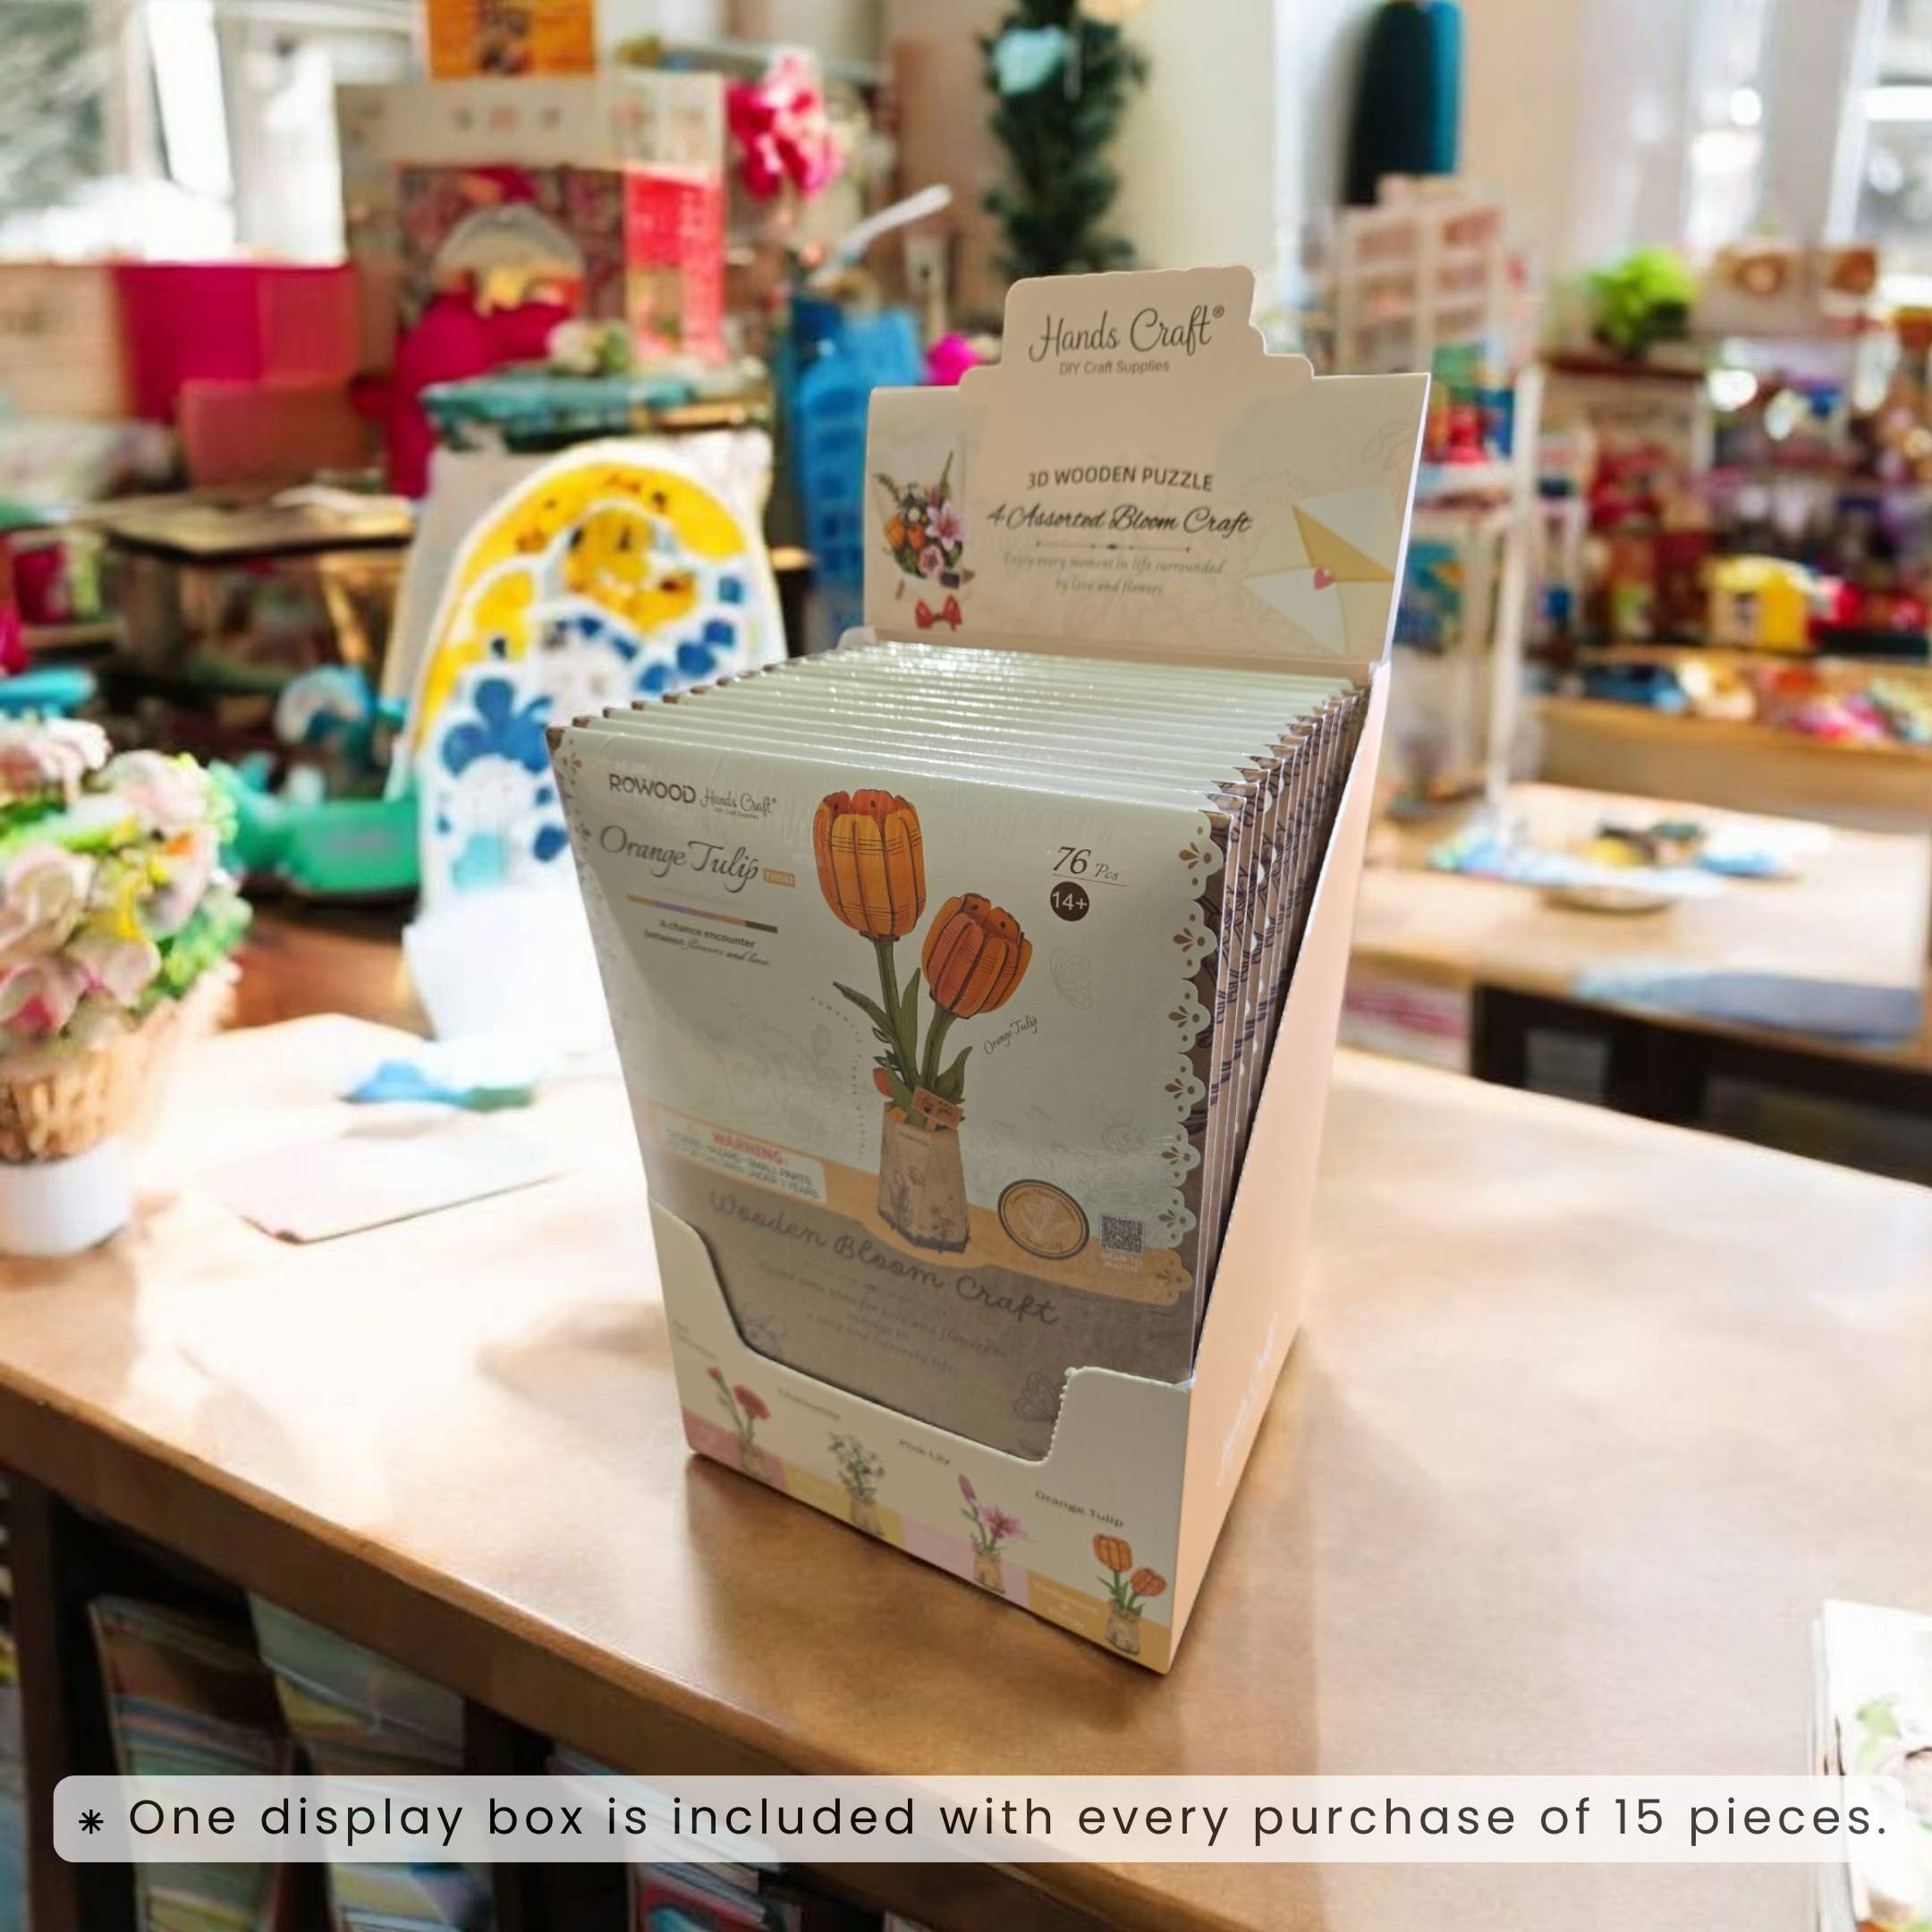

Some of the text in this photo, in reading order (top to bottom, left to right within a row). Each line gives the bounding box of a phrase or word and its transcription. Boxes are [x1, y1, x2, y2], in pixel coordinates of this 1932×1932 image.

[1029, 309, 1120, 362] Hands
[1059, 359, 1170, 376] DIY Craft Supplies
[1028, 465, 1213, 492] 3D WOODEN PUZZLE
[987, 503, 1252, 538] 4 Assorted Bloom Craft
[1036, 555, 1065, 572] every
[1070, 557, 1114, 571] moment
[1117, 557, 1128, 570] in
[1156, 557, 1225, 574] surrounded
[1070, 578, 1093, 591] love
[1097, 579, 1120, 592] and
[608, 773, 697, 804] ROWOOD
[699, 787, 738, 809] Hands
[600, 825, 759, 894] Orange Tulip
[1052, 846, 1120, 881] 76 Pcs
[1051, 890, 1089, 911] 14+
[704, 930, 756, 948] encounter
[984, 1030, 1013, 1055] Orange
[708, 1187, 827, 1248] Wooden
[833, 1233, 945, 1289] Bloom
[955, 1274, 1059, 1325] Craft
[1034, 1489, 1124, 1529] Orange Tulip
